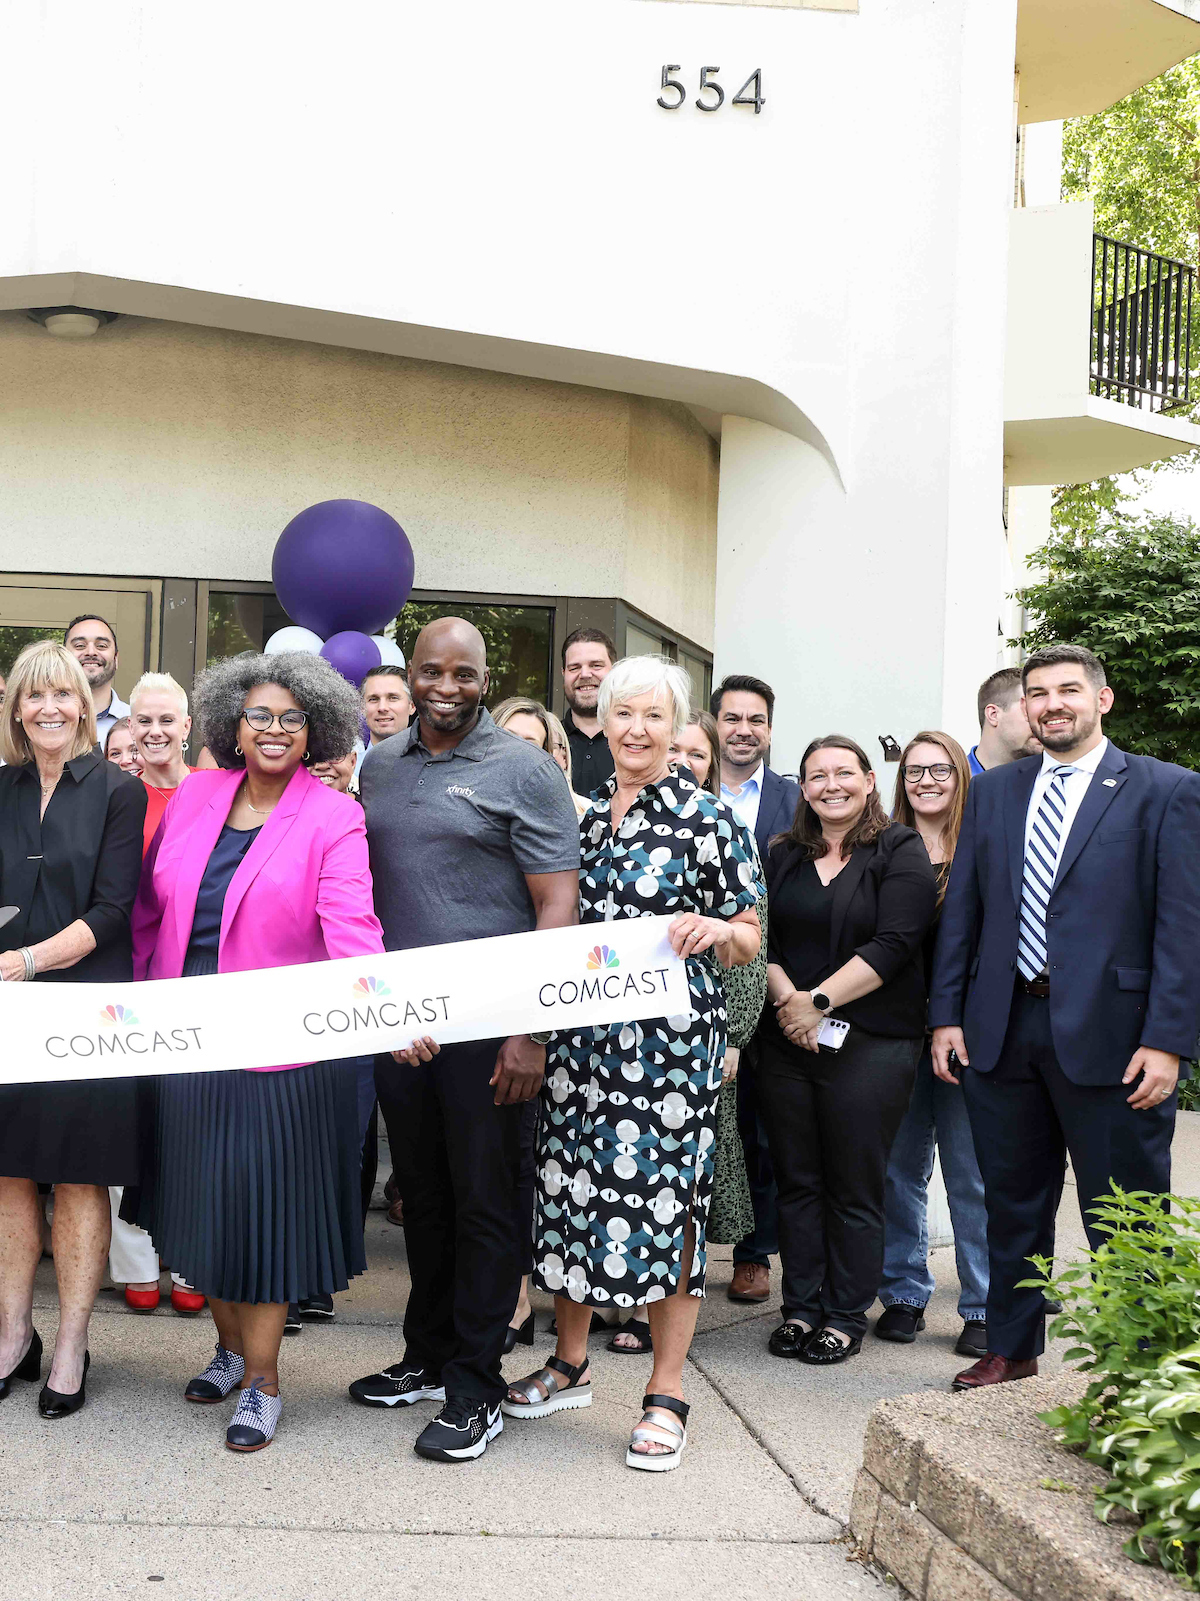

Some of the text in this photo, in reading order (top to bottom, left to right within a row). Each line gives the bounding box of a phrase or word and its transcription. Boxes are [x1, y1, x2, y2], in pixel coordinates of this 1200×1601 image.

[657, 64, 766, 115] 554
[446, 785, 476, 797] xfinity
[539, 968, 669, 1007] COMCAST
[303, 996, 451, 1035] COMCAST
[45, 1027, 203, 1058] COMCAST
